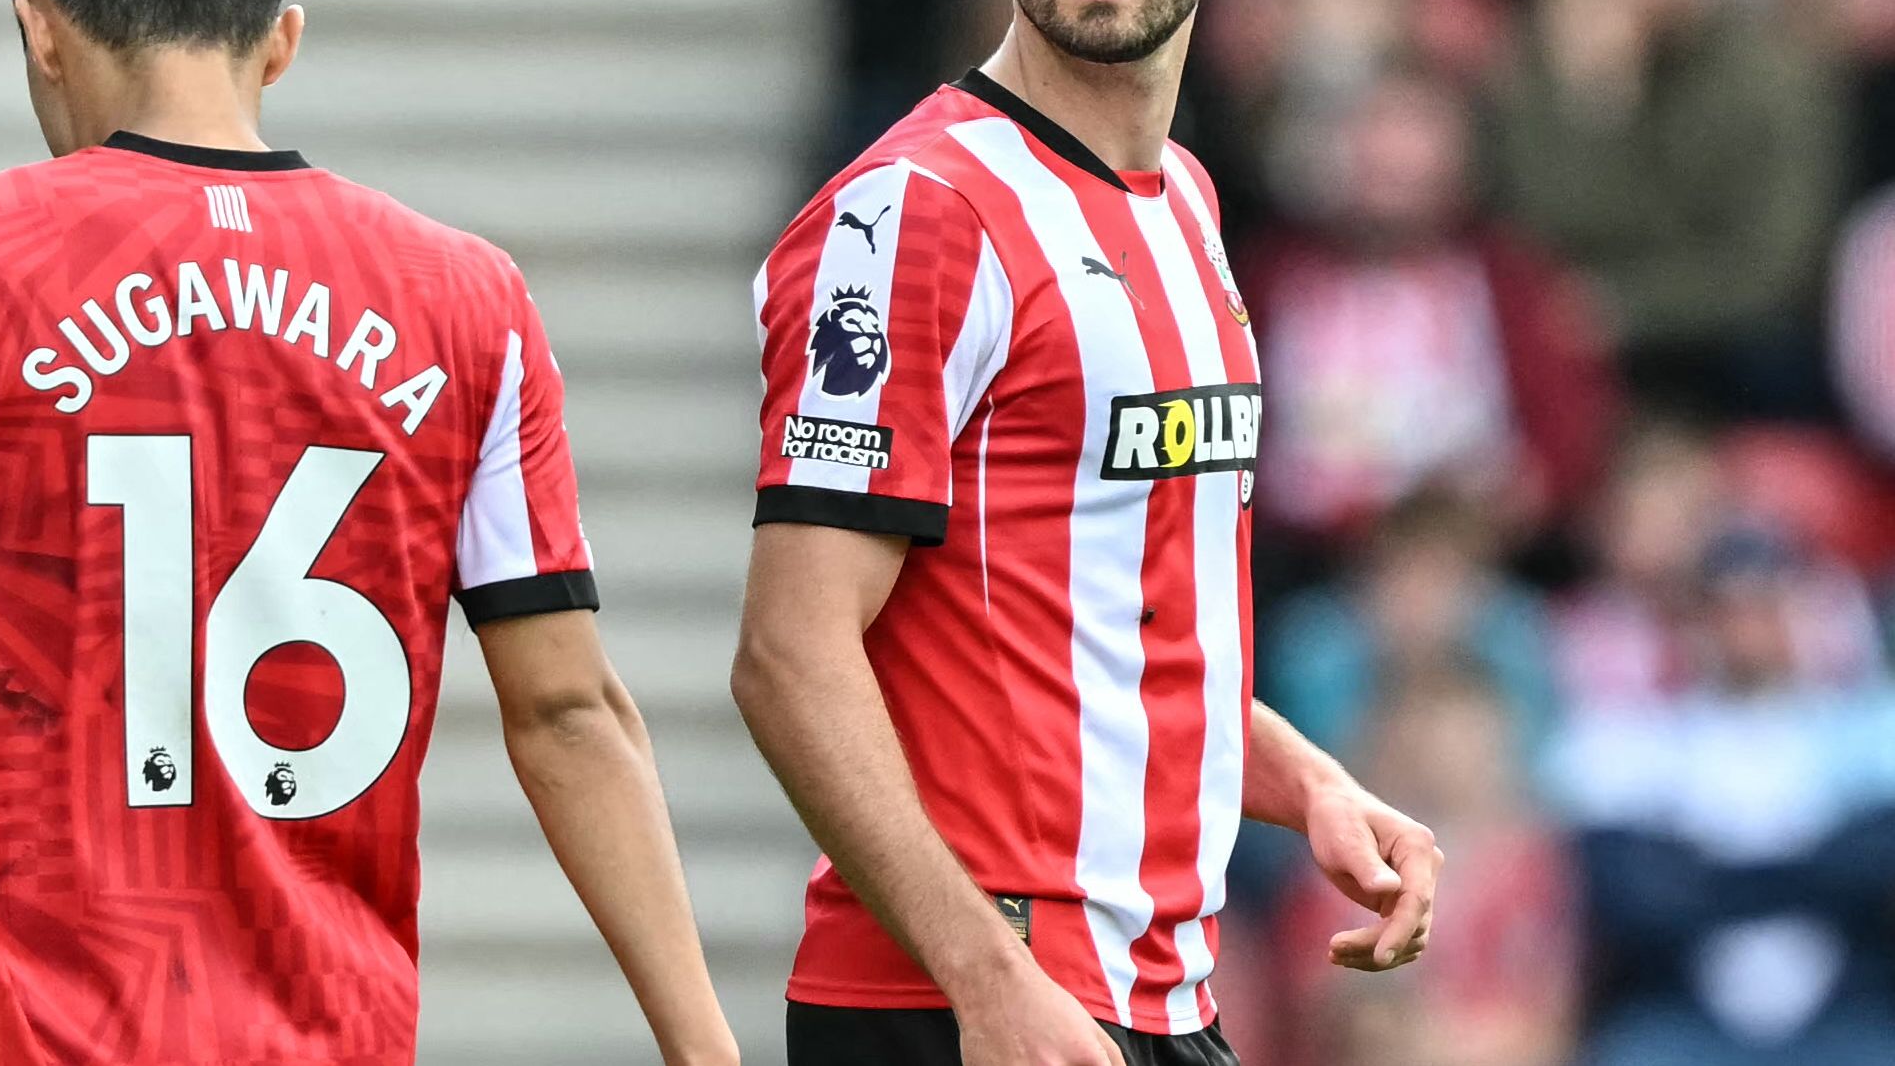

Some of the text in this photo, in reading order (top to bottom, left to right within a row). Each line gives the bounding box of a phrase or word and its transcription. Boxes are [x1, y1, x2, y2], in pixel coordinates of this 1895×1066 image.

[21, 258, 448, 436] SUGAWARA
[784, 416, 881, 449] No room
[812, 442, 889, 469] racism
[1112, 394, 1262, 469] ROLLBI
[86, 433, 412, 822] 16
